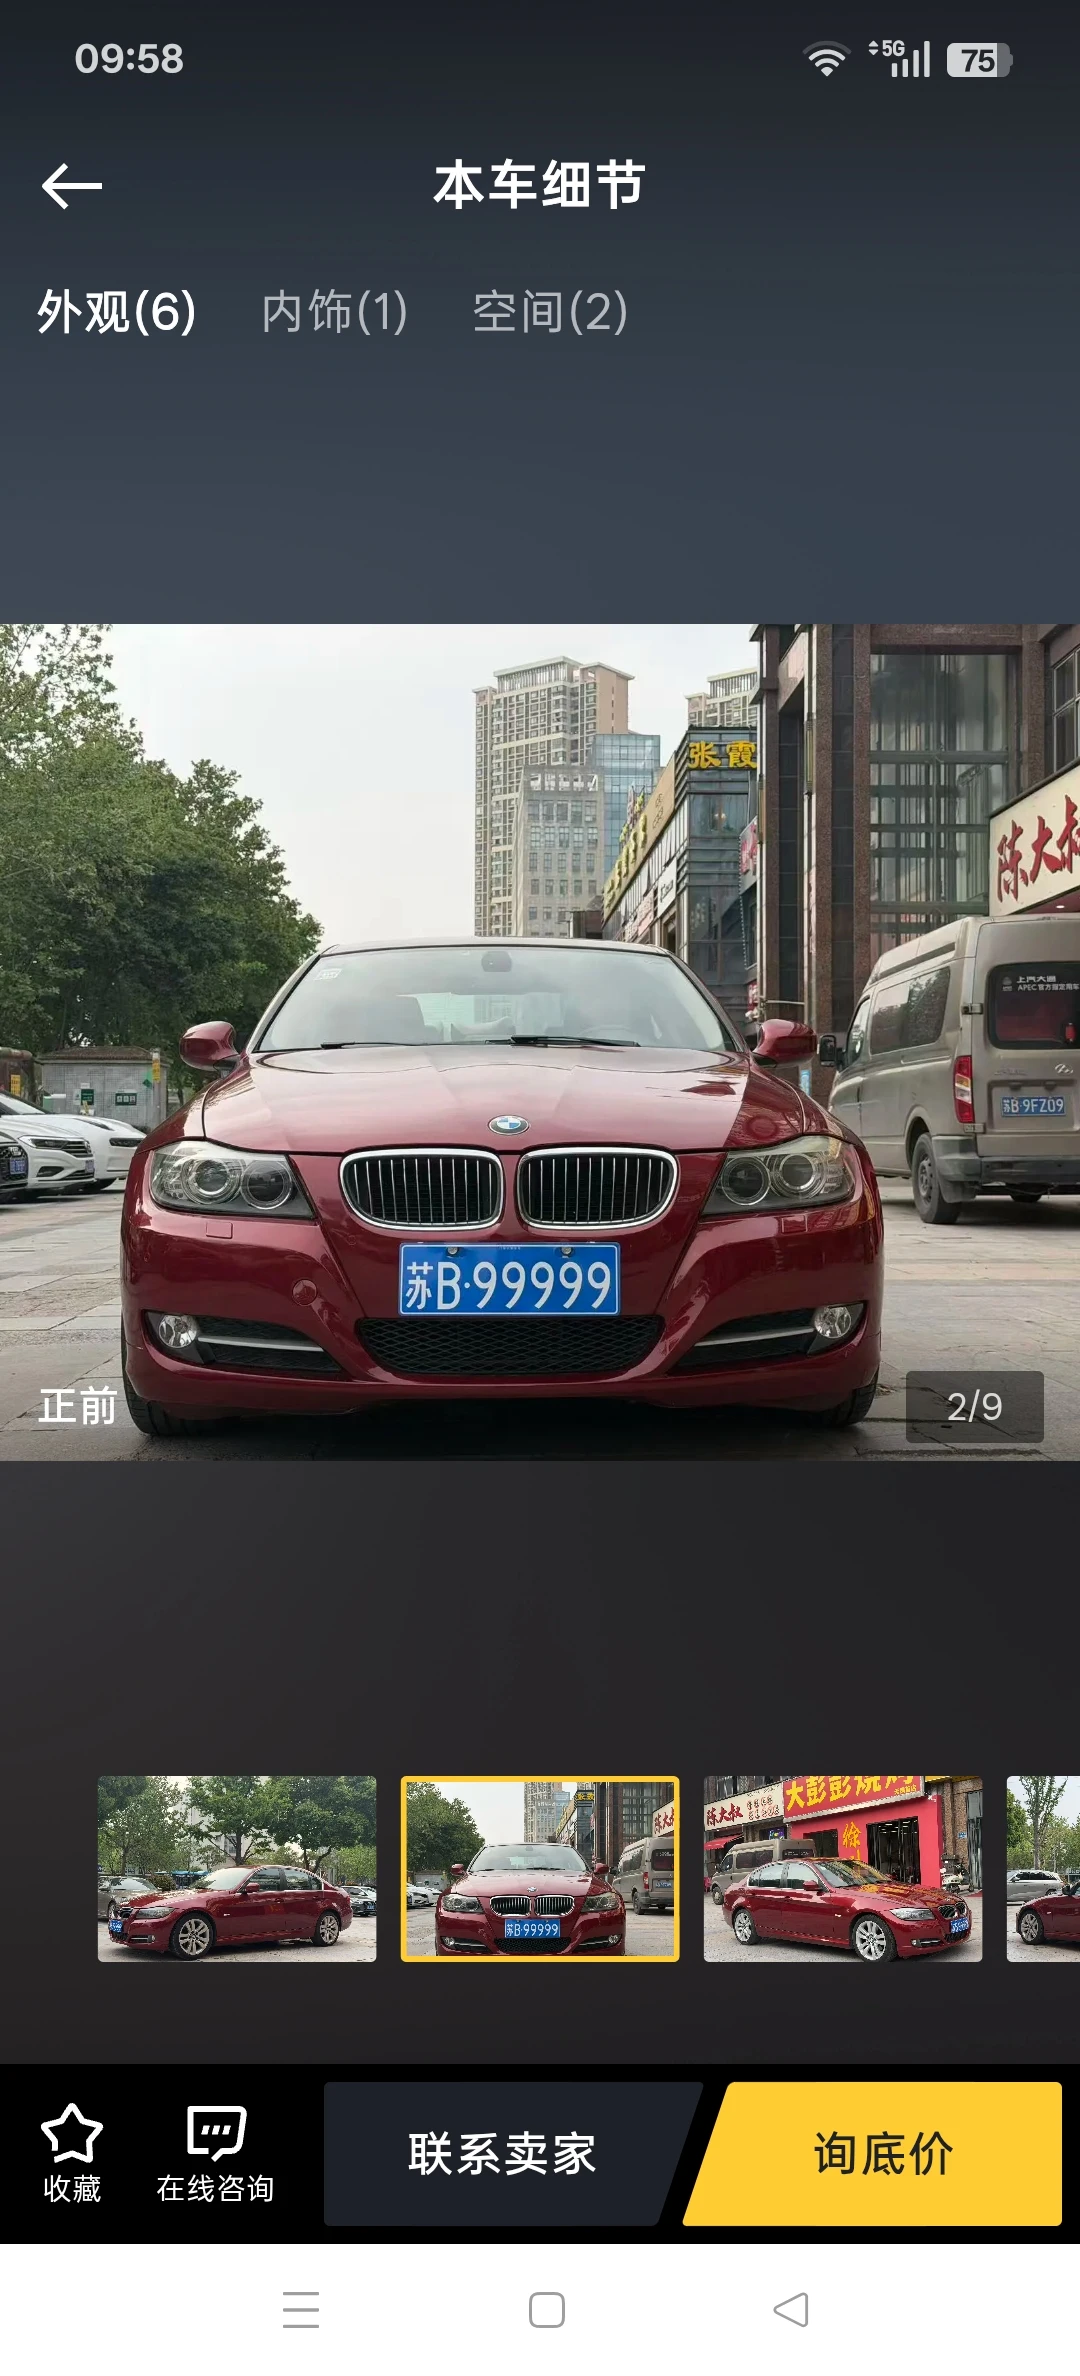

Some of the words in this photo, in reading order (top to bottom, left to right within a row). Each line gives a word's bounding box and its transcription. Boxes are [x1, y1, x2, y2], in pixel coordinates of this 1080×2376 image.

[75, 44, 184, 74] 09:58
[882, 40, 905, 56] 5G
[961, 49, 995, 72] 75
[433, 158, 646, 209] 本车细节
[37, 288, 195, 336] 外观(6)
[263, 288, 407, 336] 内饰(1)
[473, 288, 627, 336] 空间(2)
[405, 1261, 611, 1310] 苏B·99999
[506, 1923, 559, 1937] 苏B·99999
[408, 2131, 597, 2176] 联系卖家
[814, 2131, 954, 2176] 询底价
[43, 2174, 102, 2203] 收藏
[157, 2174, 274, 2203] 在线咨询
